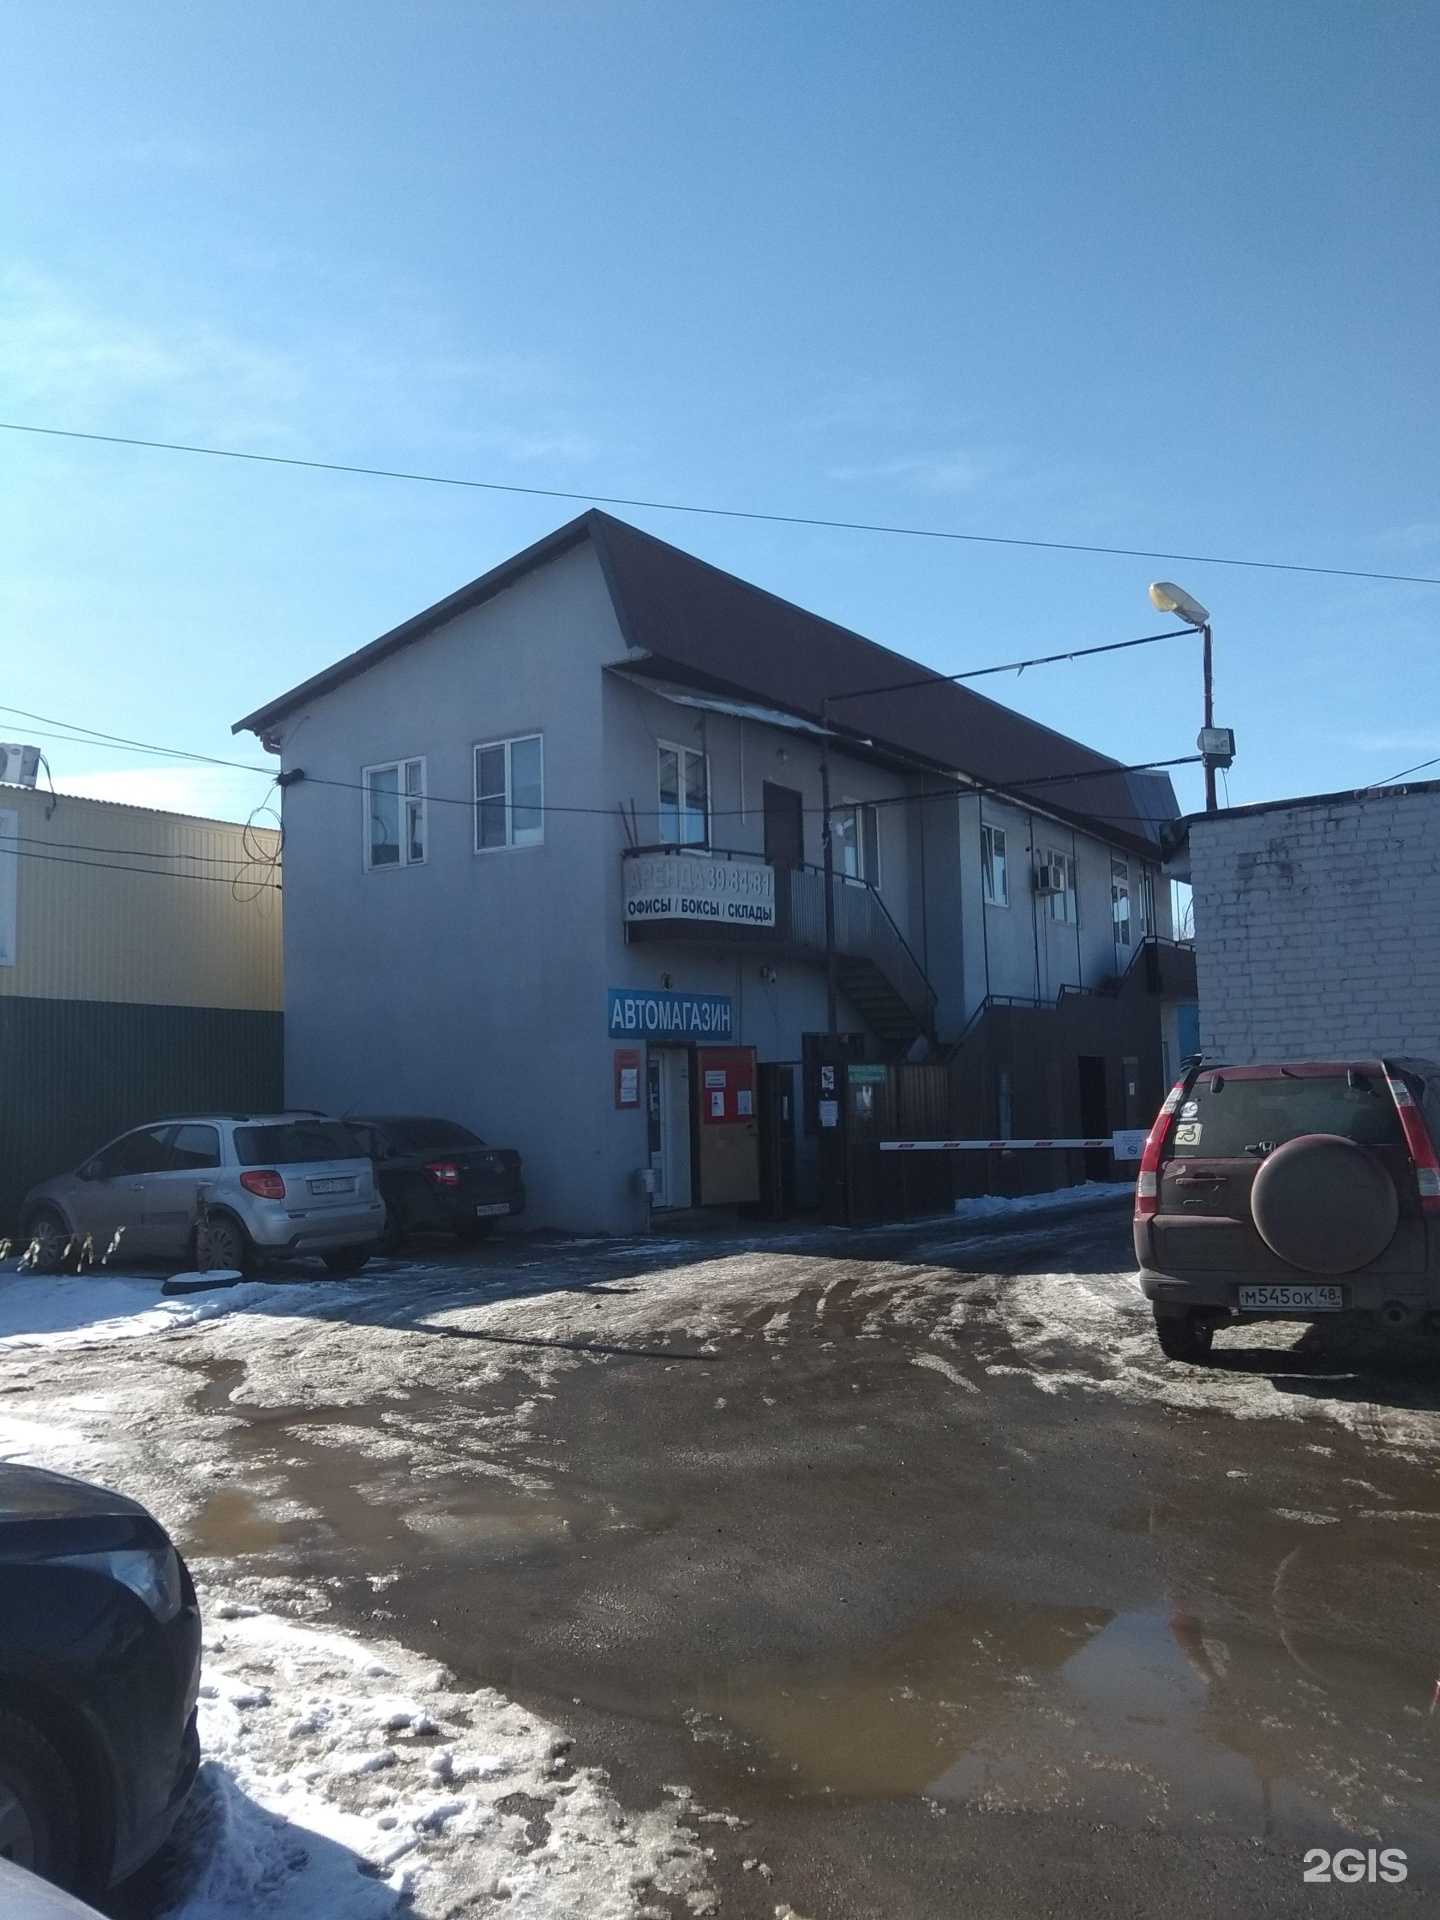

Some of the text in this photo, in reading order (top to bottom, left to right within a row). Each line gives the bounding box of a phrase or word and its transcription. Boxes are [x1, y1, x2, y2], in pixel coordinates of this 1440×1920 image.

[628, 898, 671, 916] ОФИСЫ
[681, 898, 720, 916] БОКСЫ
[727, 903, 772, 922] СКЛАДЫ
[611, 998, 731, 1032] АВТОМАГАЗИН
